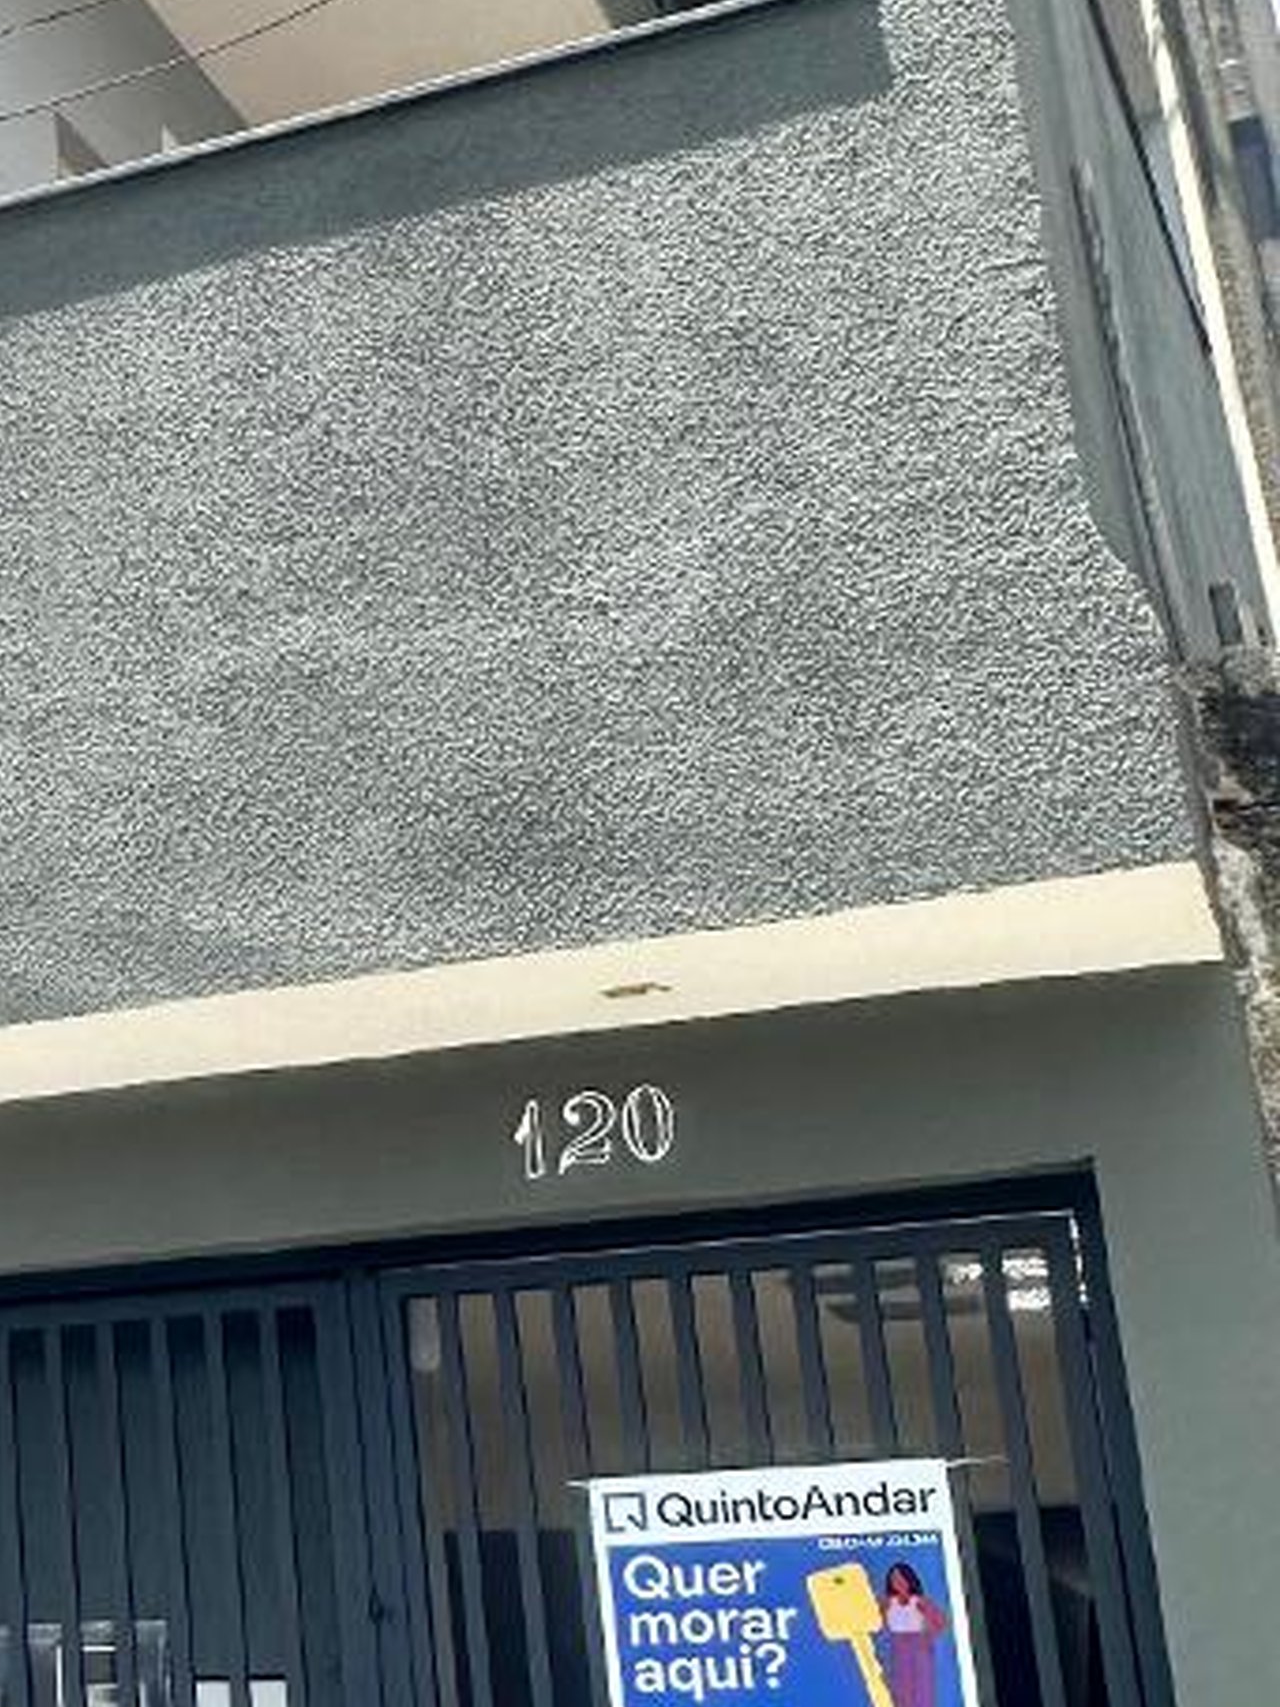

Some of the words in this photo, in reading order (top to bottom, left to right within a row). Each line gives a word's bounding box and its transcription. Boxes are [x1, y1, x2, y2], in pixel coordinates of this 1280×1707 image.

[513, 1084, 674, 1179] 120
[655, 1482, 936, 1528] QuintoAndar
[623, 1555, 765, 1600] Quer
[629, 1607, 797, 1646] morar
[634, 1644, 788, 1702] aqui?
